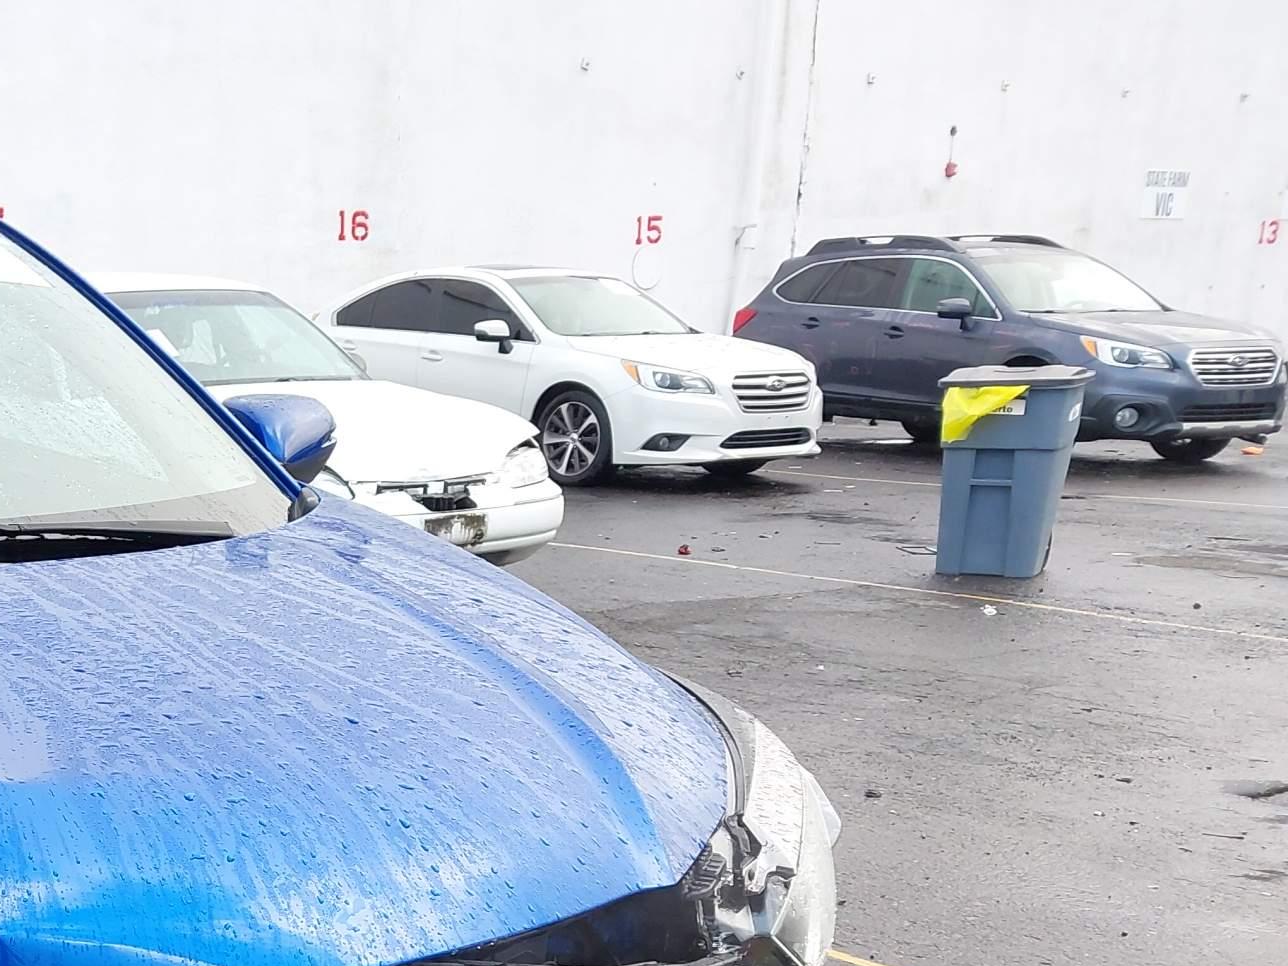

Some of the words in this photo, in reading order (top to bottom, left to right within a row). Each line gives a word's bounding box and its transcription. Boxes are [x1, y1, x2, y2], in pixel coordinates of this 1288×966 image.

[1145, 170, 1168, 188] STATE
[1168, 170, 1191, 188] FARM
[1154, 192, 1175, 217] VIC
[337, 210, 369, 241] 16
[635, 214, 663, 245] 15
[1258, 220, 1280, 245] 13
